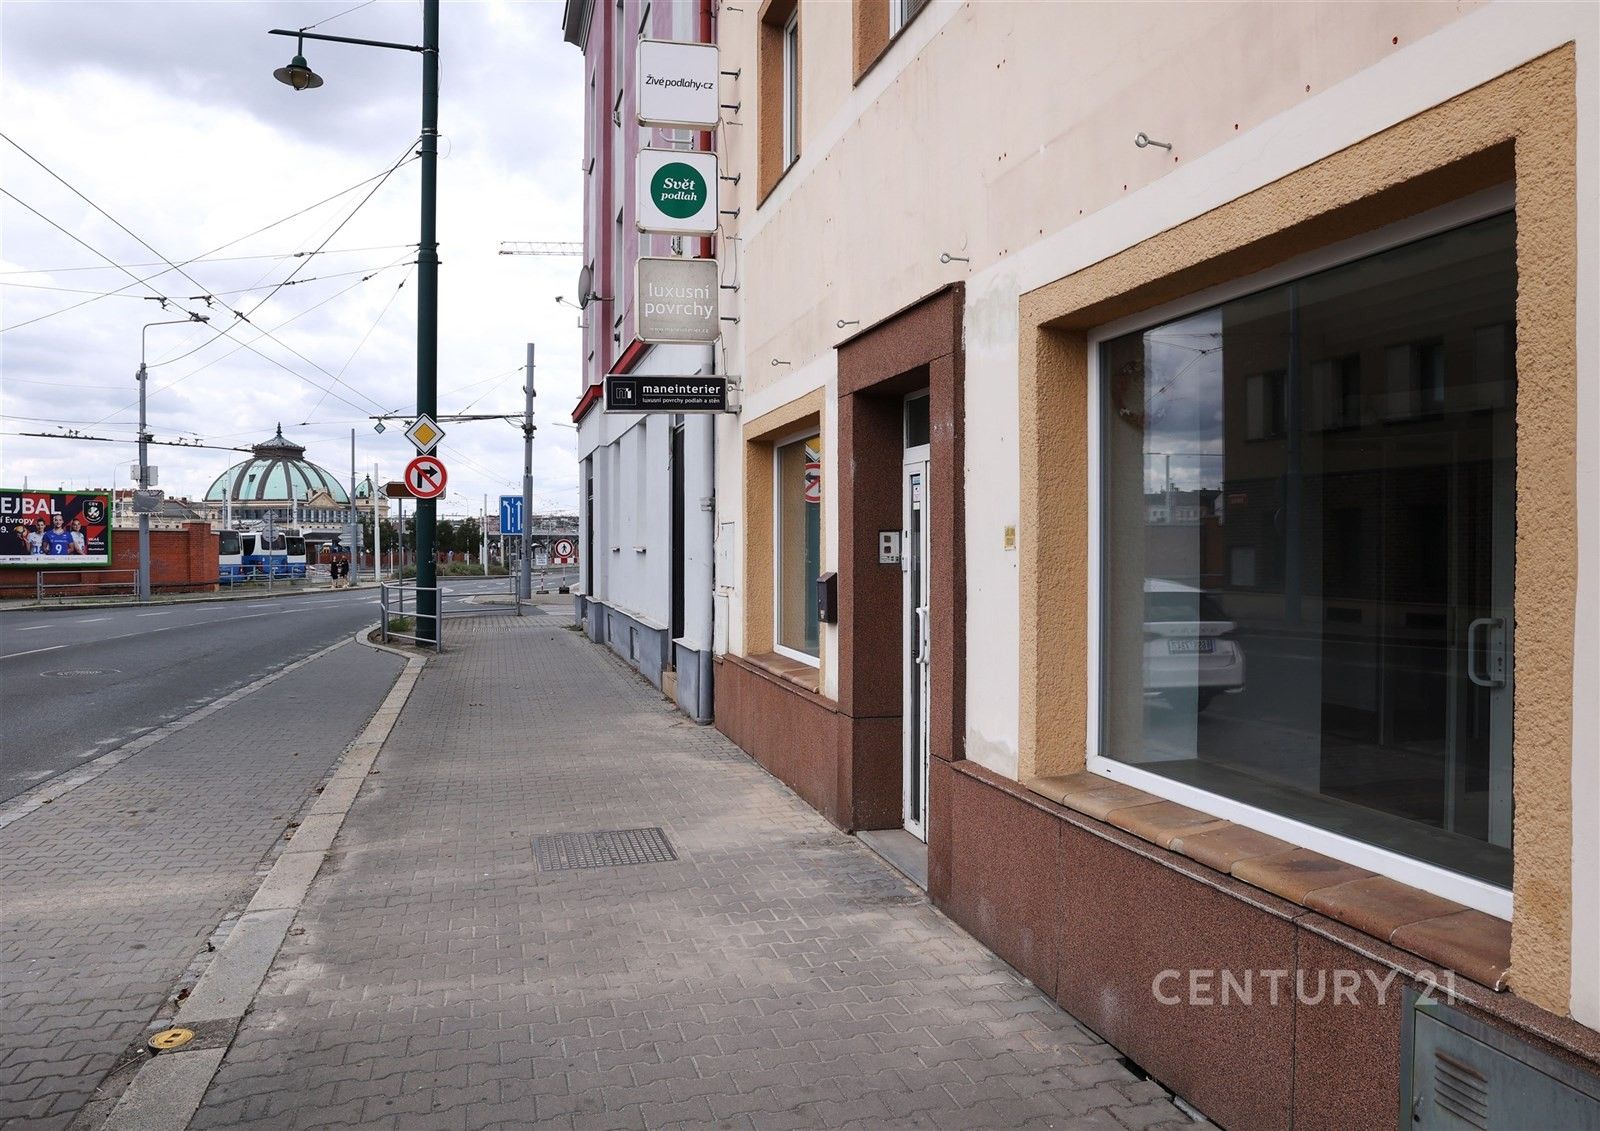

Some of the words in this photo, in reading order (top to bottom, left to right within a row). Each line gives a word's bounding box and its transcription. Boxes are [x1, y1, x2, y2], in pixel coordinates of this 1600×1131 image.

[663, 177, 696, 190] Svět
[661, 191, 698, 201] podlah
[649, 283, 710, 299] luxusní
[645, 301, 714, 319] povrchy
[642, 384, 721, 394] maneinterier
[5, 516, 35, 525] Evropy
[55, 544, 62, 554] 9
